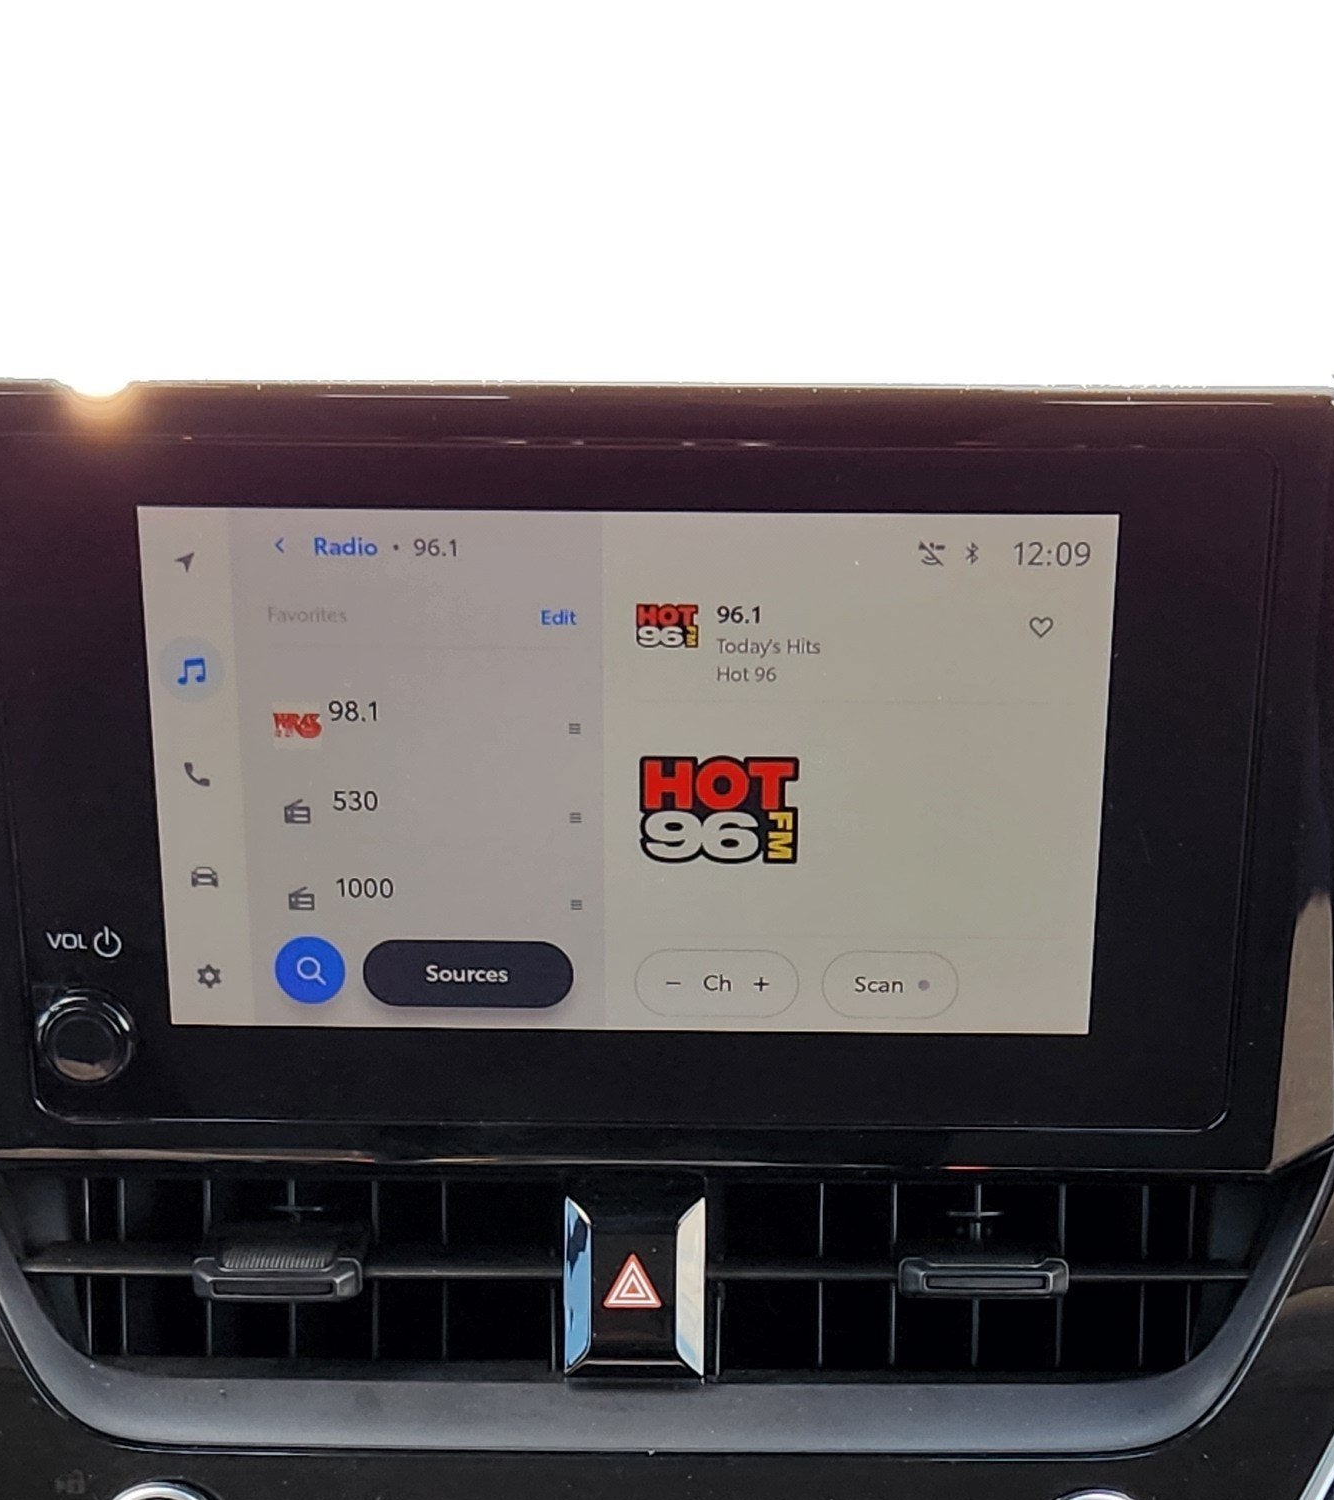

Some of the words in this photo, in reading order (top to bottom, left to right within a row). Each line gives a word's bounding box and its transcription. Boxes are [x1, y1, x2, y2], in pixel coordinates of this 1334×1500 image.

[314, 537, 378, 557] Radio
[413, 539, 459, 558] 96.1
[1013, 541, 1091, 568] 12:09
[267, 606, 347, 624] Favorites
[540, 609, 577, 627] Edit
[637, 604, 698, 627] HOT
[717, 606, 761, 624] 96.1
[637, 626, 684, 648] 96
[717, 639, 781, 658] Today's
[787, 638, 821, 654] Hits
[717, 667, 749, 682] Hot
[755, 667, 777, 682] 96
[328, 700, 379, 722] 98.1
[641, 757, 798, 811] HOT
[333, 790, 379, 812] 530
[641, 811, 762, 862] 96
[765, 811, 798, 863] FM
[336, 878, 394, 899] 1000
[46, 932, 88, 949] VOL
[425, 962, 509, 983] Sources
[703, 974, 732, 993] Ch
[854, 976, 904, 994] Scan
